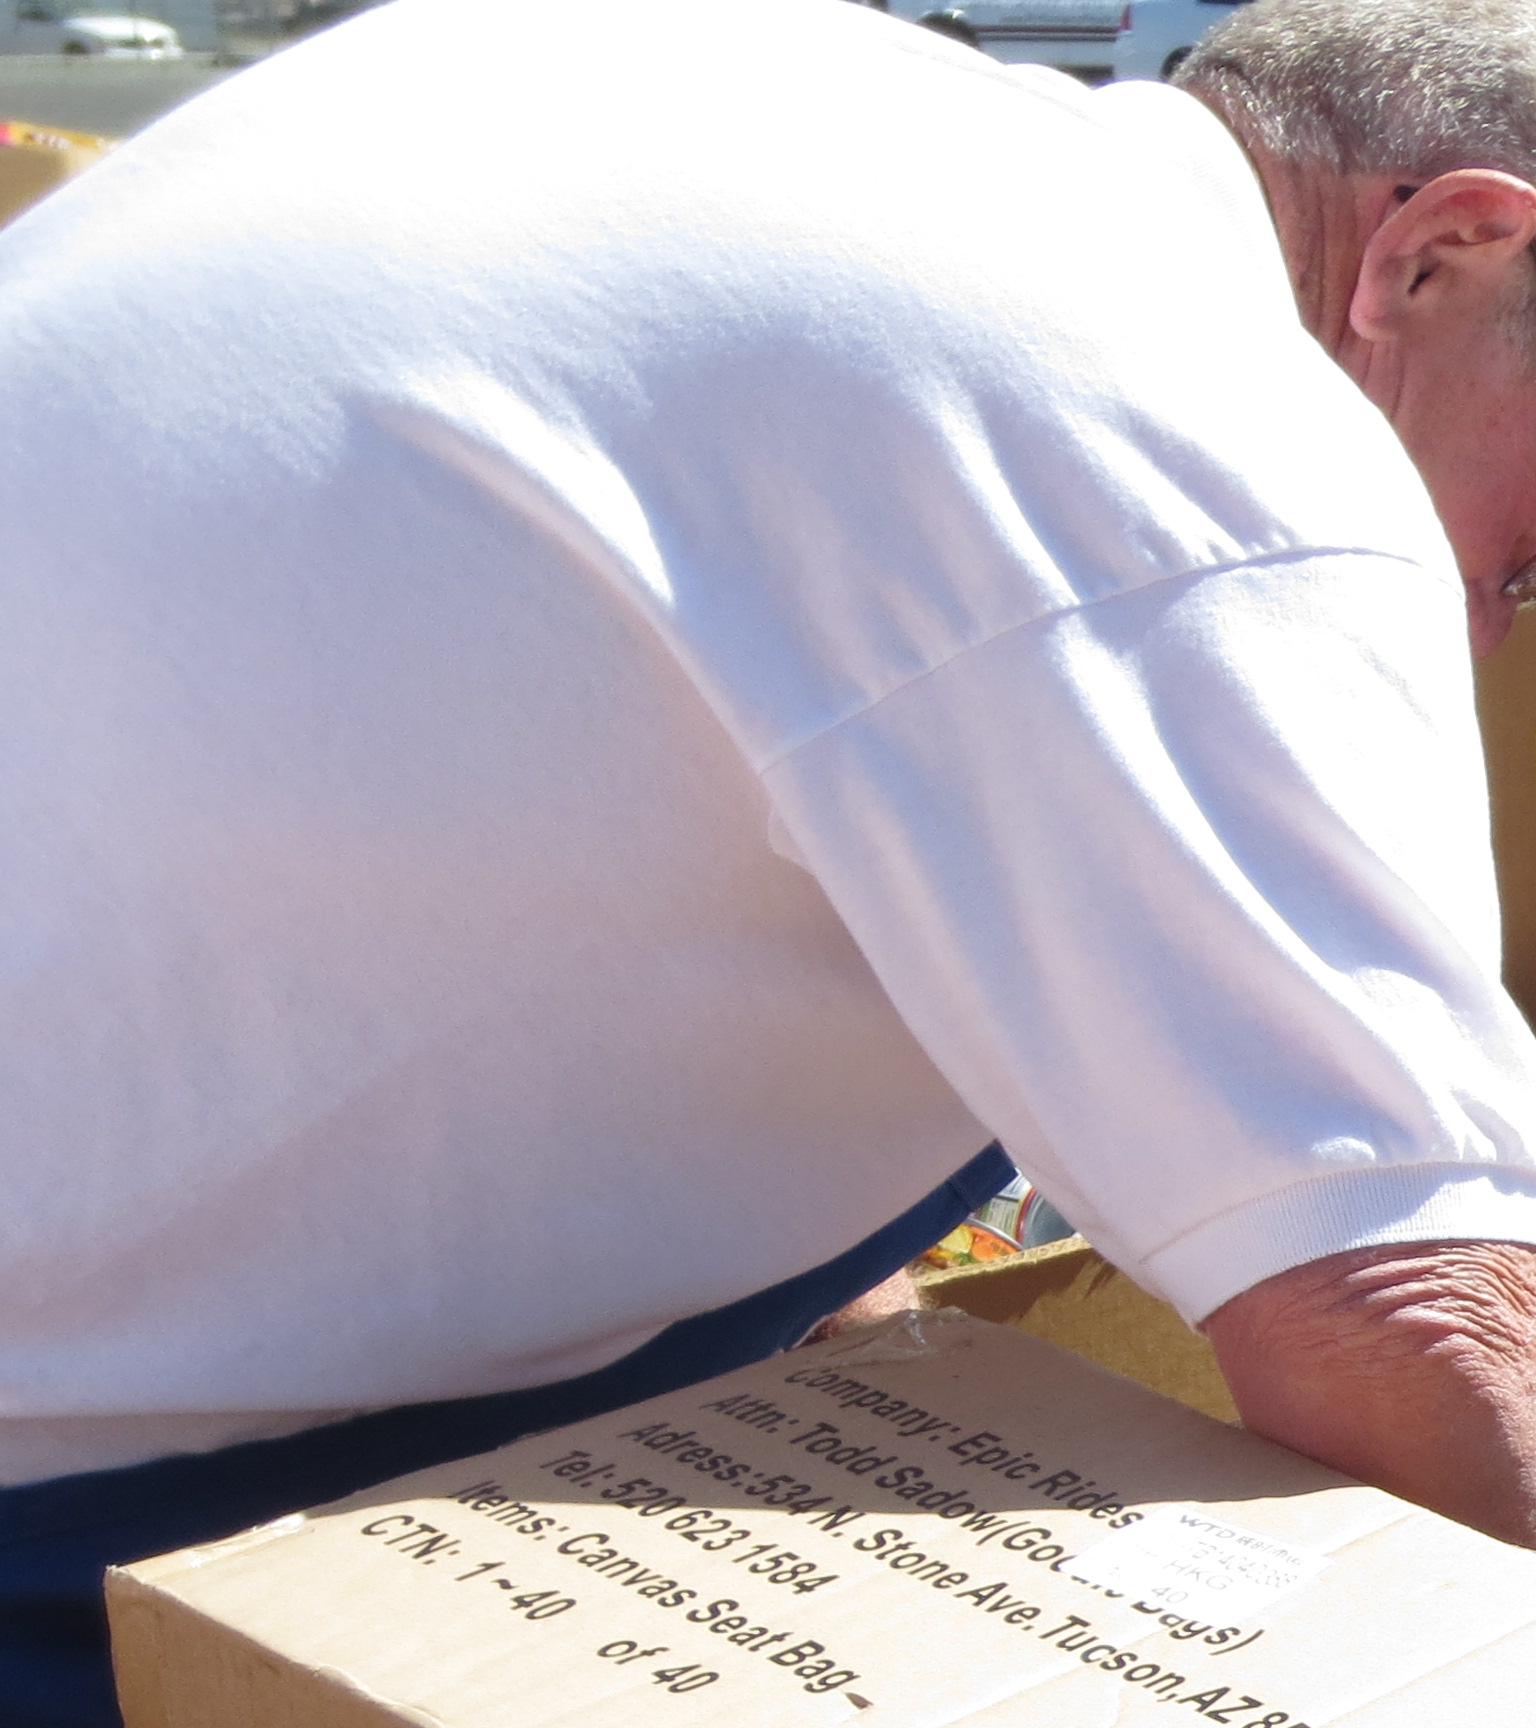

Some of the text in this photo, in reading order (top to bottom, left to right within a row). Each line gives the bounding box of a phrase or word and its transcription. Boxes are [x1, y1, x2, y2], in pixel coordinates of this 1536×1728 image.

[701, 1393, 798, 1435] Attn:
[790, 1422, 897, 1476] Todd
[948, 1429, 1041, 1483] Epic
[1031, 1469, 1145, 1530] Rides
[360, 1514, 461, 1565] CTN:
[540, 1449, 840, 1596] Tel: 520 623 1584
[806, 1505, 866, 1538] N.
[853, 1529, 971, 1590] Stone
[444, 1479, 862, 1694] Items: Canvas Seat Bag
[596, 1638, 721, 1695] of 40
